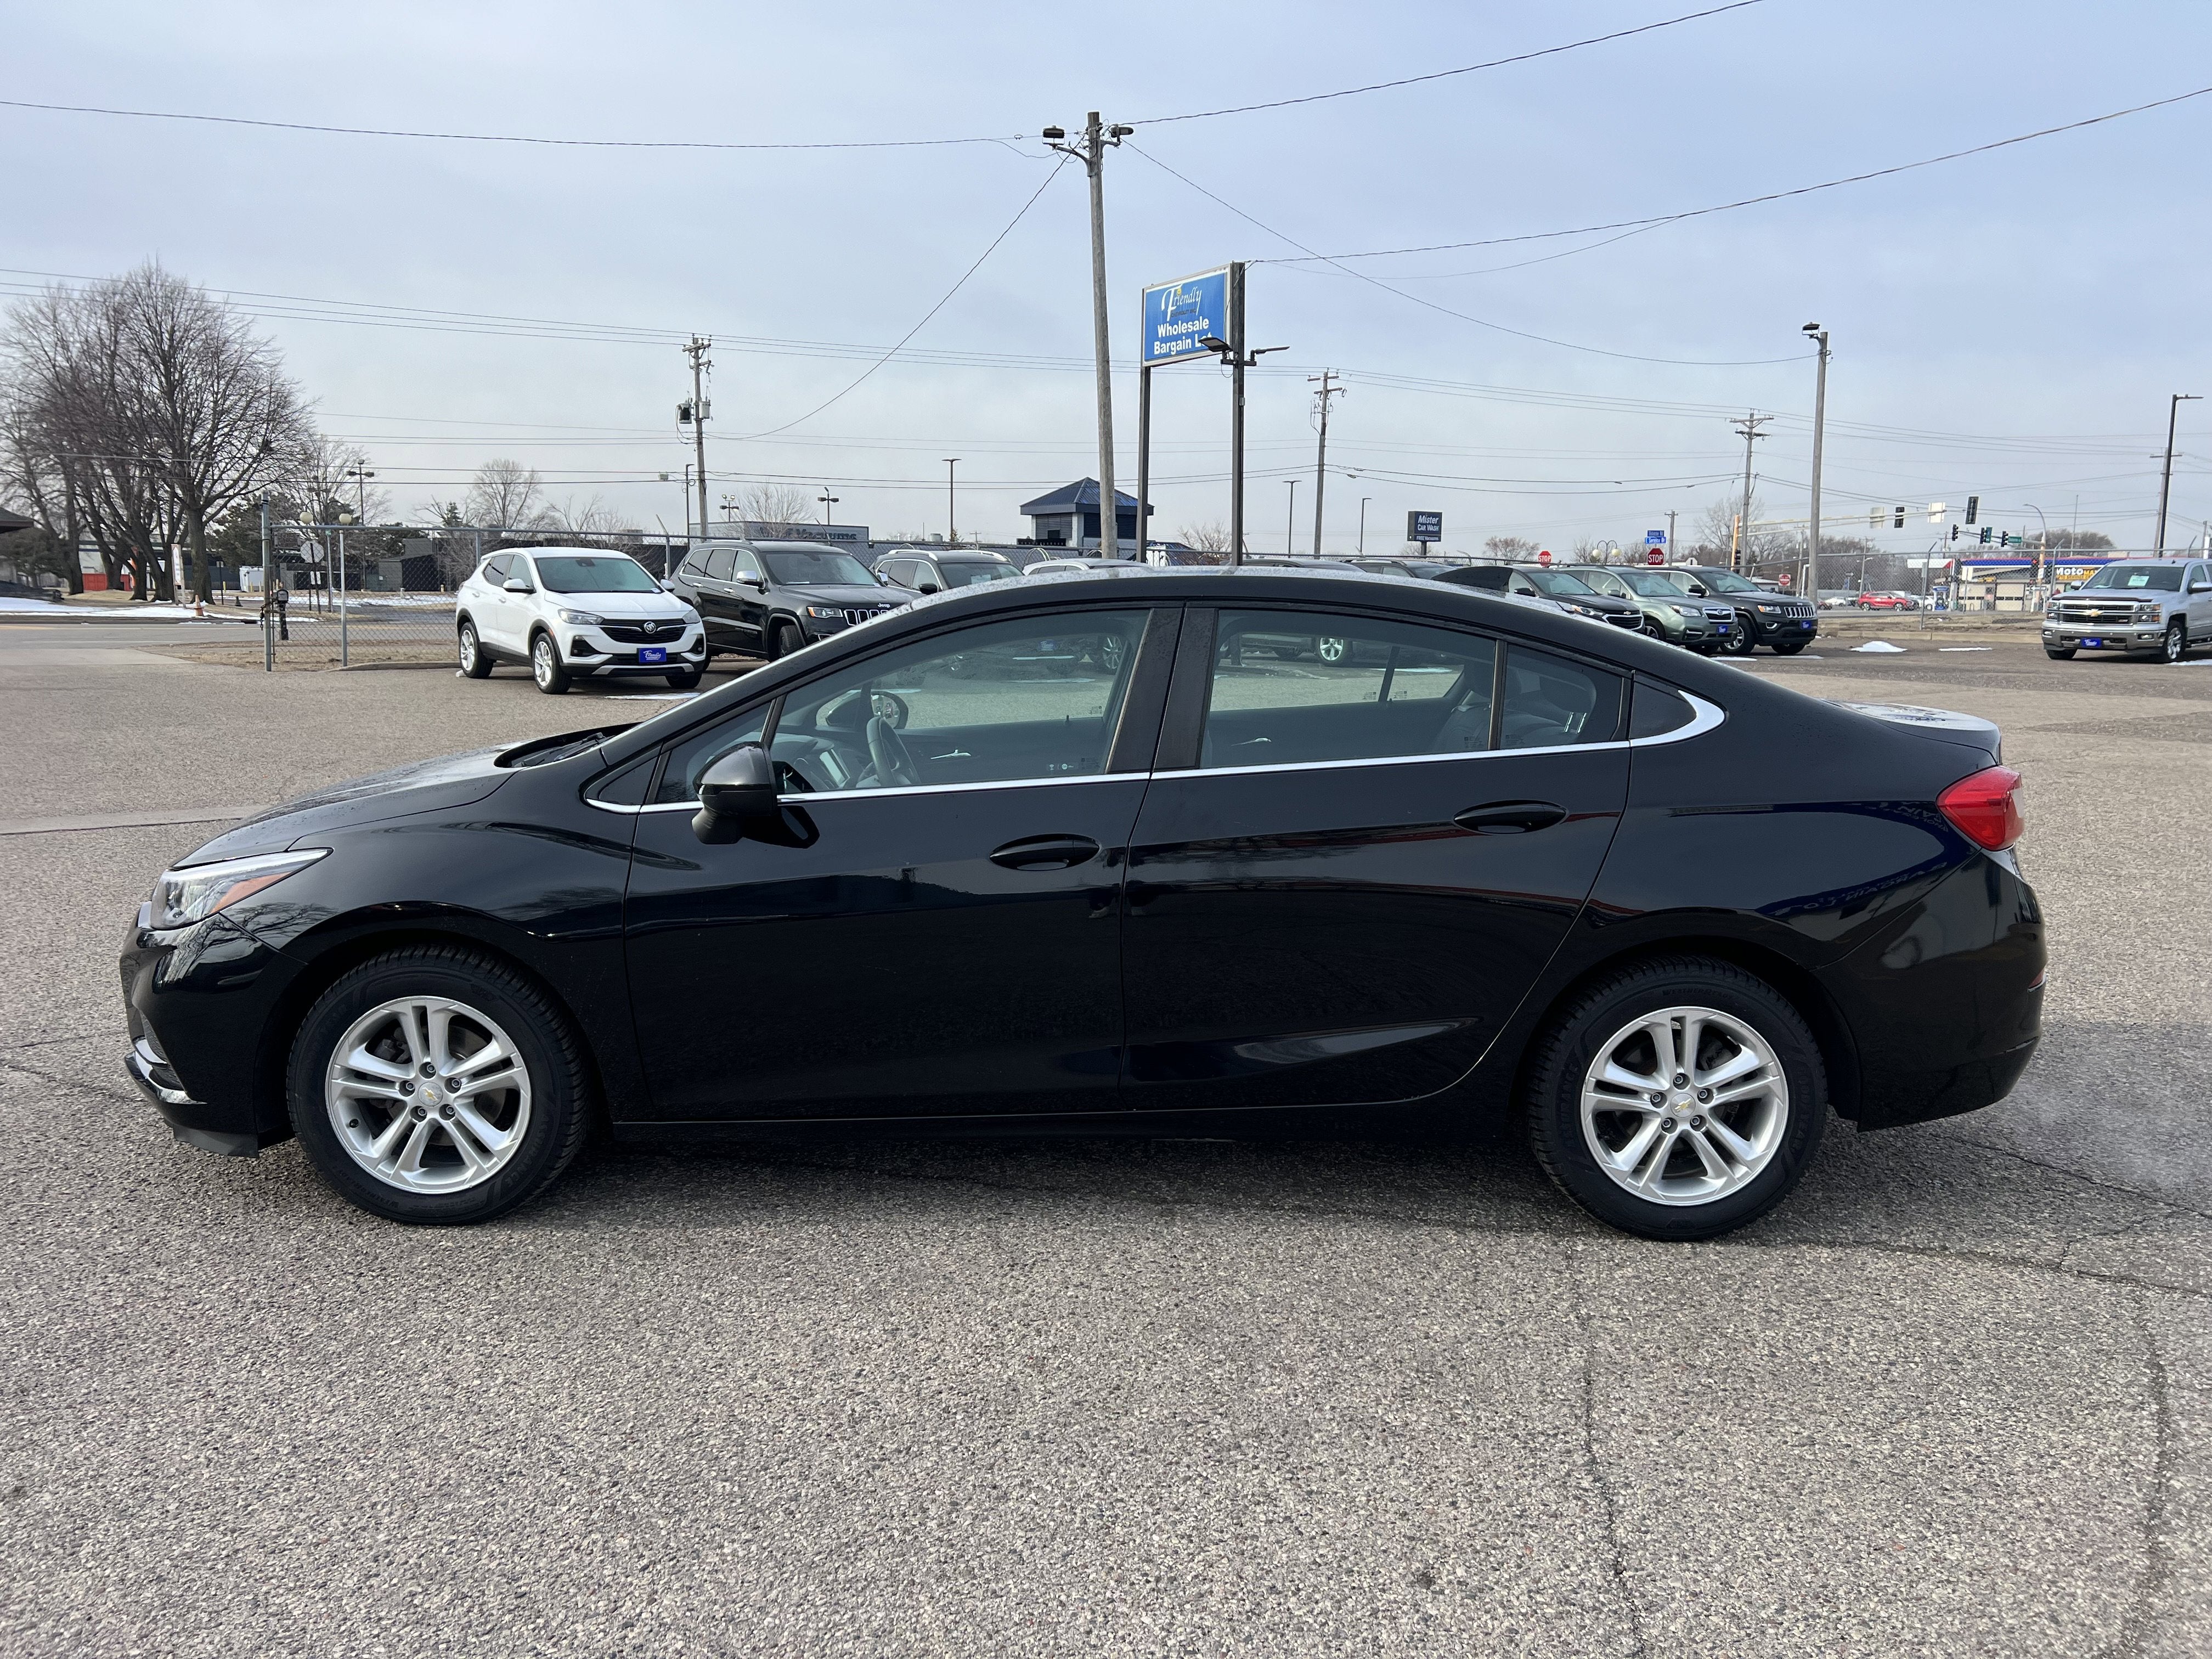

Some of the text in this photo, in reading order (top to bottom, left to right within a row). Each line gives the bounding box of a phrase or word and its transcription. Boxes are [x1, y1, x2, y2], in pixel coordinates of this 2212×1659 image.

[1161, 284, 1202, 321] Friendly
[1158, 316, 1209, 338] Wholesale
[1154, 336, 1192, 355] Bargain
[1418, 515, 1439, 524] Mister
[1648, 554, 1663, 563] STOP
